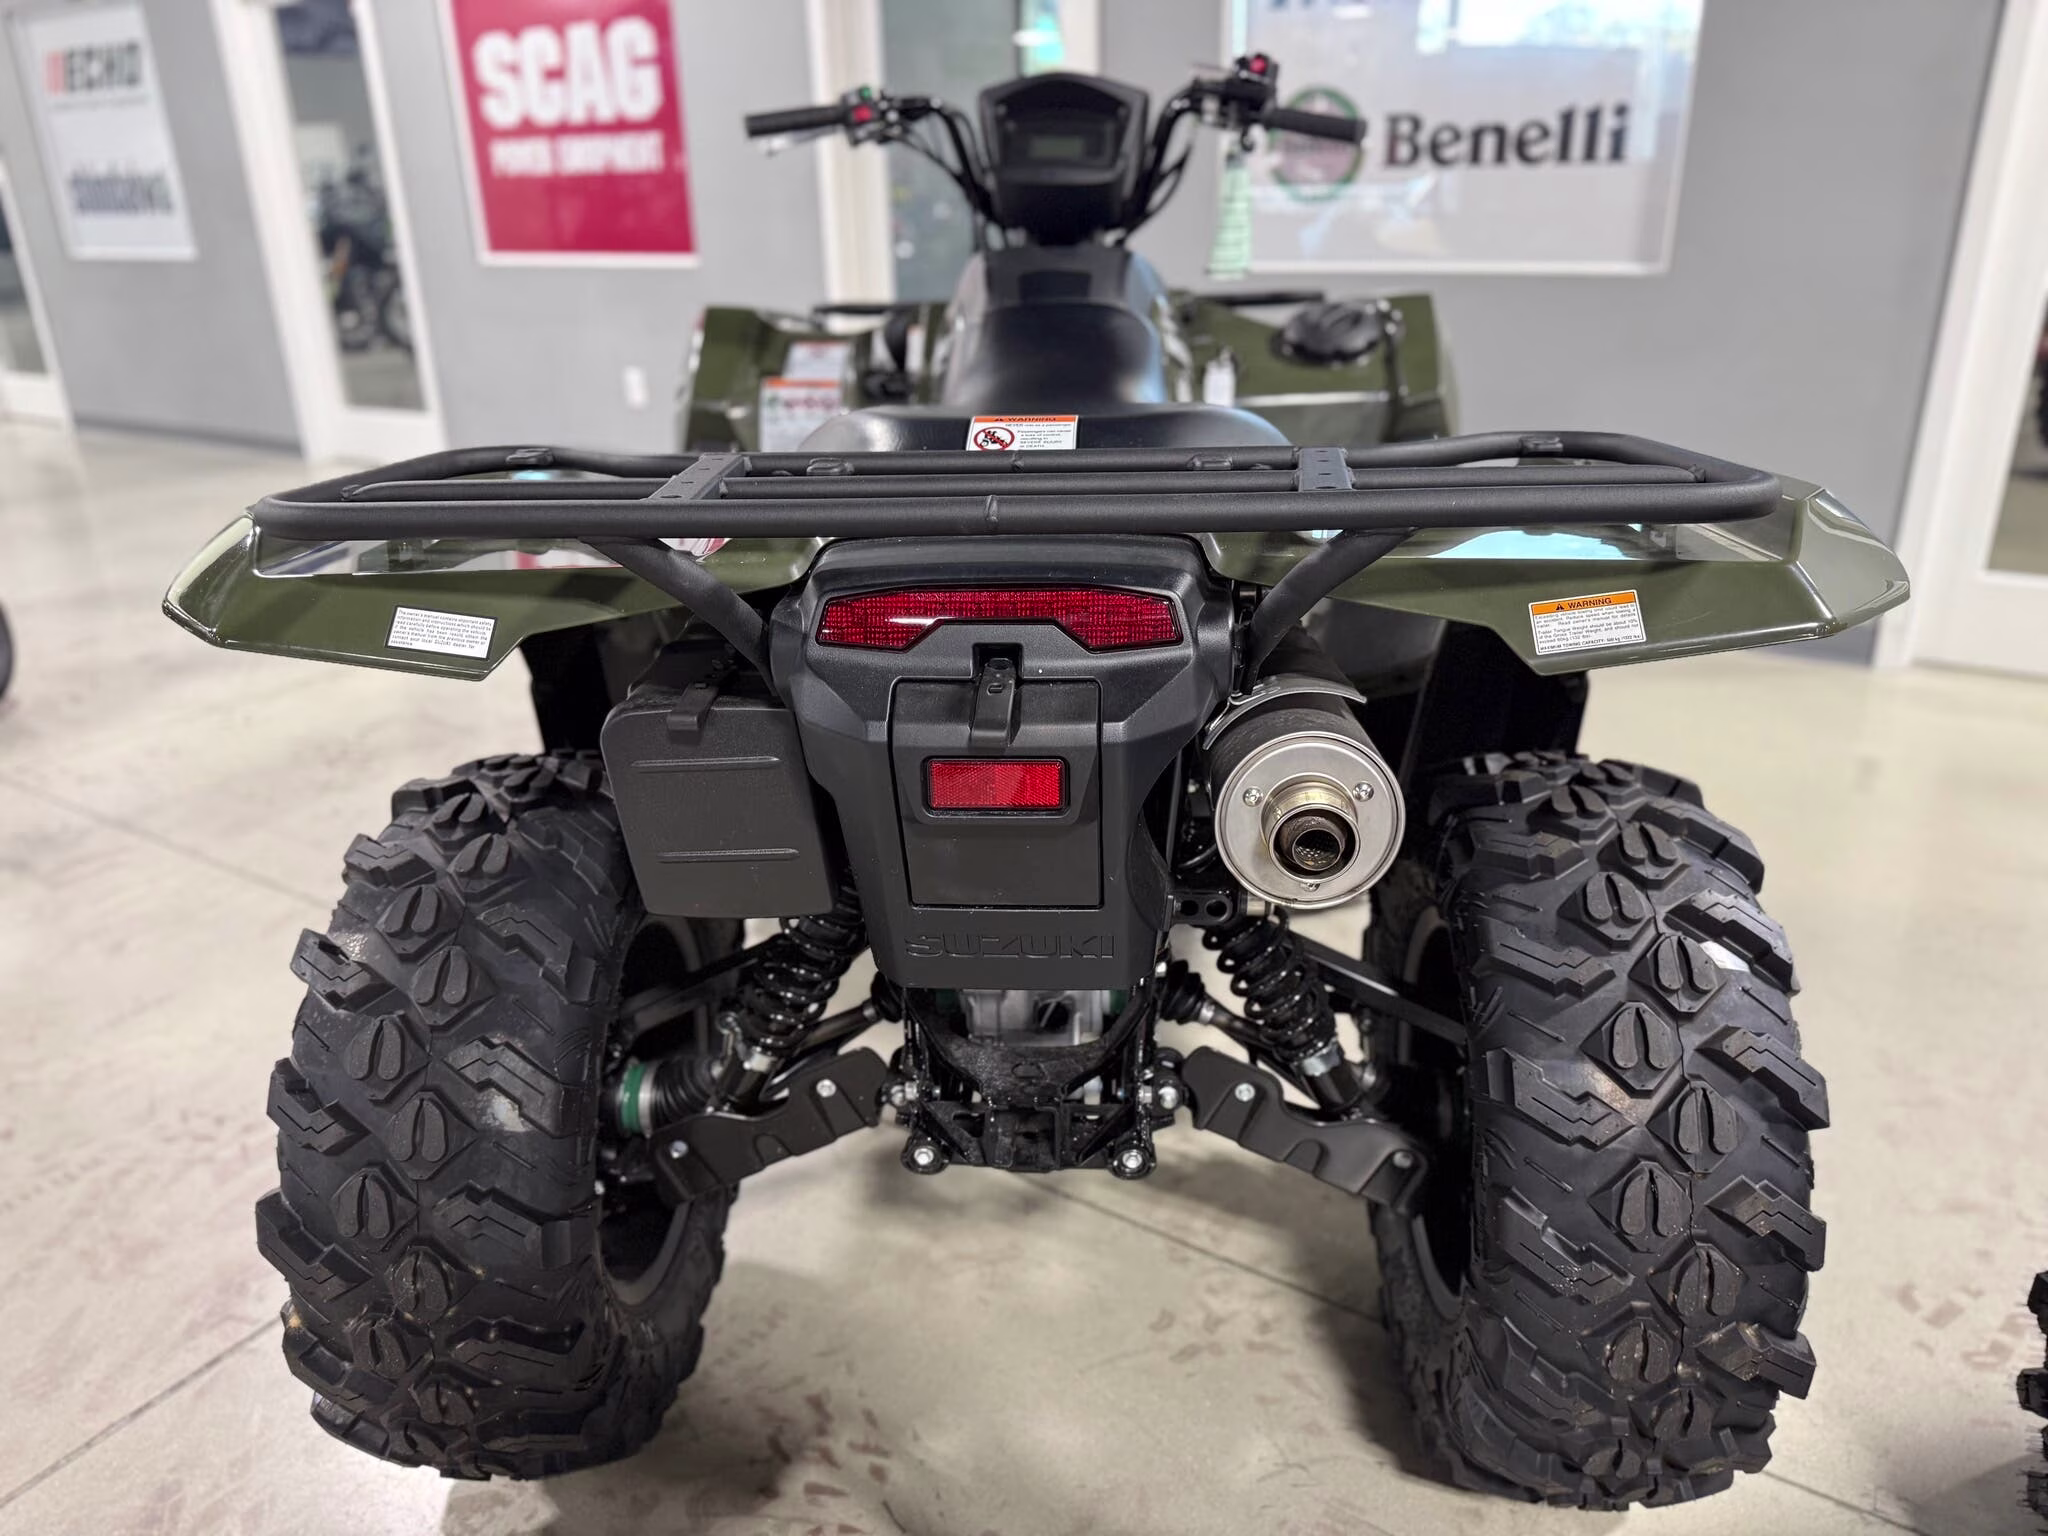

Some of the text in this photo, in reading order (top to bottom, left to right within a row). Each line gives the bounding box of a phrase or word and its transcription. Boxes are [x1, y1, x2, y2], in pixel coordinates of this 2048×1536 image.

[66, 41, 141, 93] ECHO
[471, 15, 664, 130] SCAG
[489, 135, 554, 178] POWER
[1385, 103, 1631, 167] Benelli
[1567, 597, 1612, 609] WARNING
[904, 933, 1116, 959] SUZUKI
